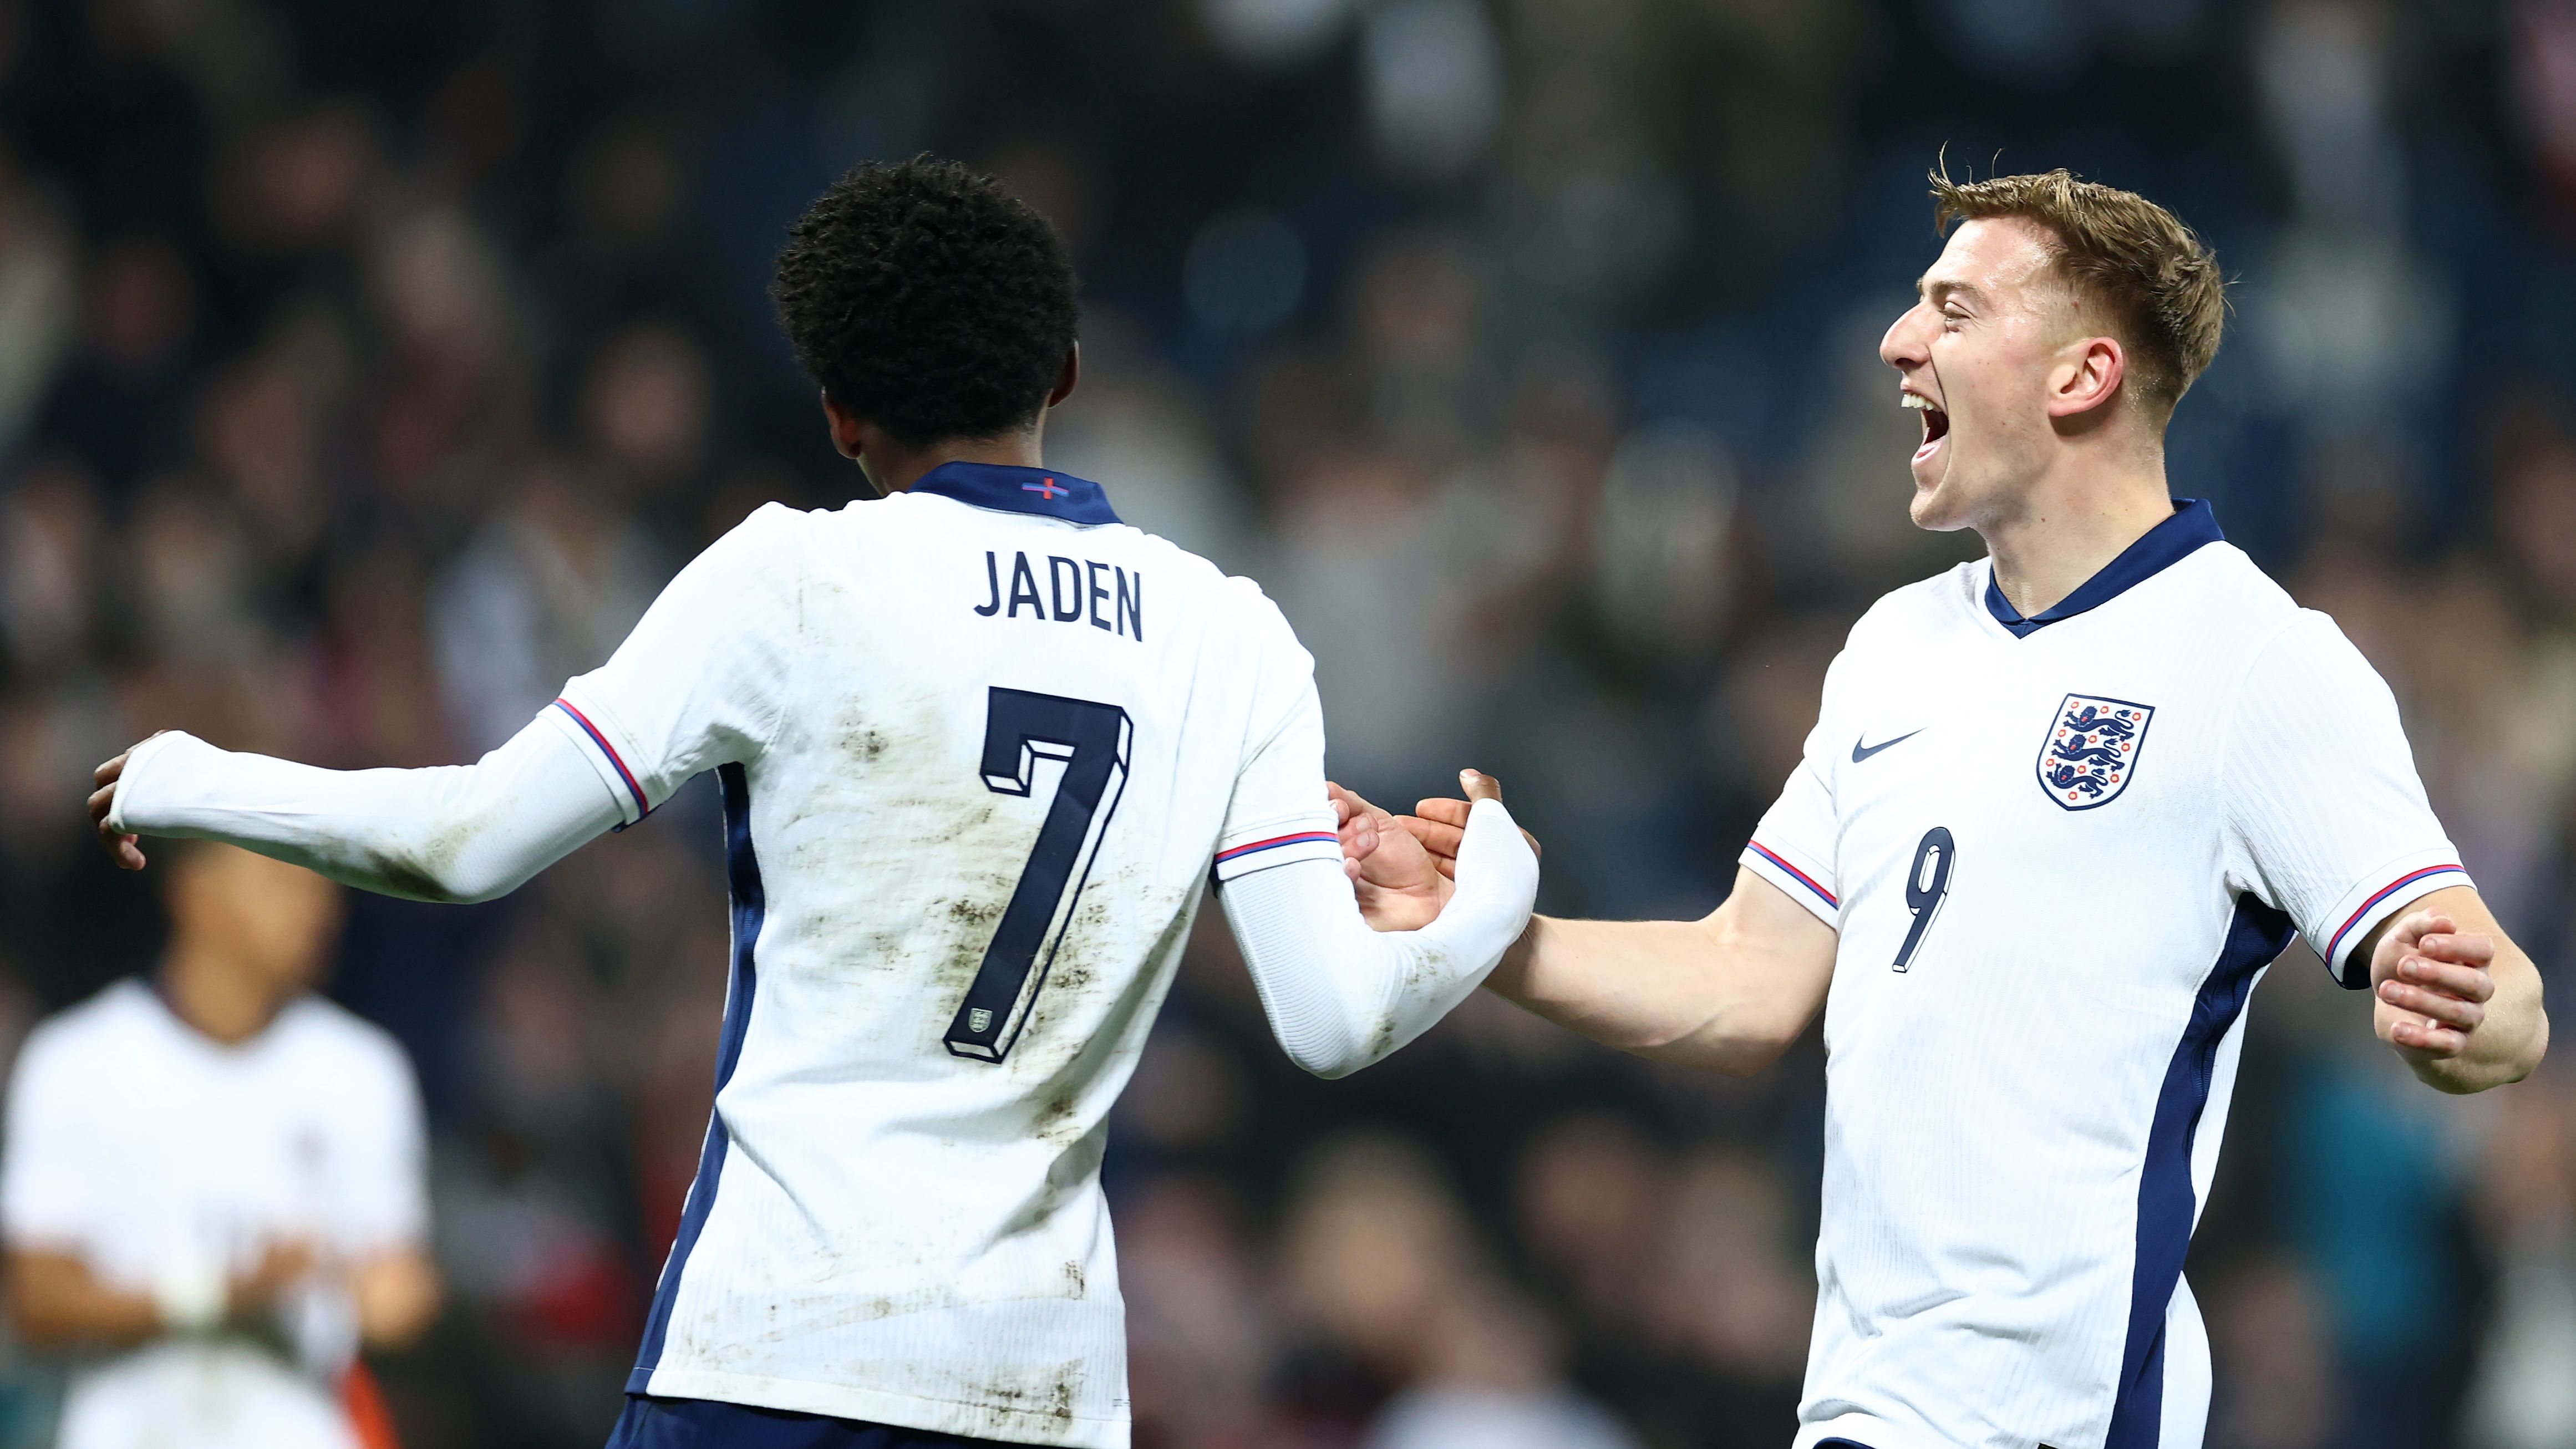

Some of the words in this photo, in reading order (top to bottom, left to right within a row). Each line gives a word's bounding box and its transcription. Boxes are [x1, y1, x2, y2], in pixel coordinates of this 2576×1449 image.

[973, 551, 1142, 642] JADEN
[943, 686, 1134, 1064] 7
[1892, 827, 1955, 973] 9
